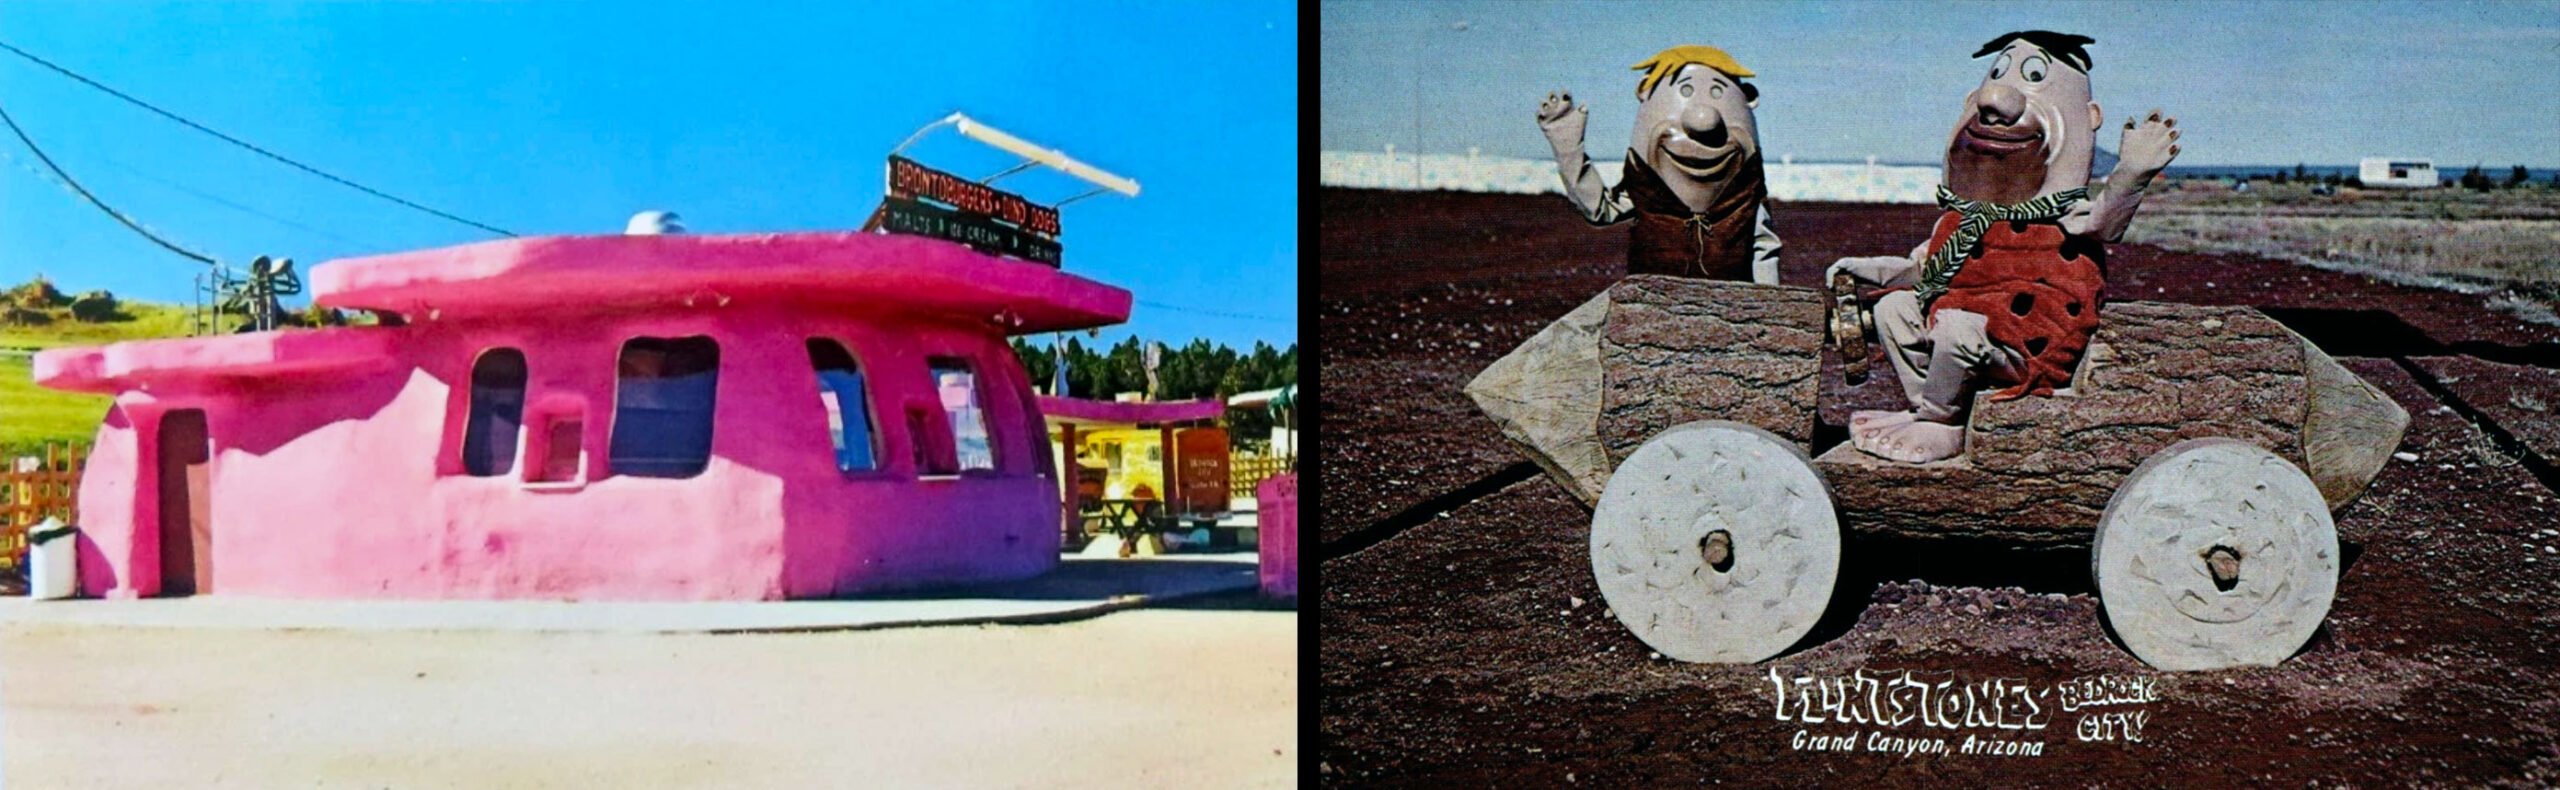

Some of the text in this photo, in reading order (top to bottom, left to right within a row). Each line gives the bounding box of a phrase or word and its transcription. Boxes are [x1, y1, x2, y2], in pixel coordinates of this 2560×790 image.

[897, 160, 1057, 232] BRONTOBURGERS DINO DOGS
[893, 211, 931, 233] MALTS
[967, 227, 1001, 247] CREAM
